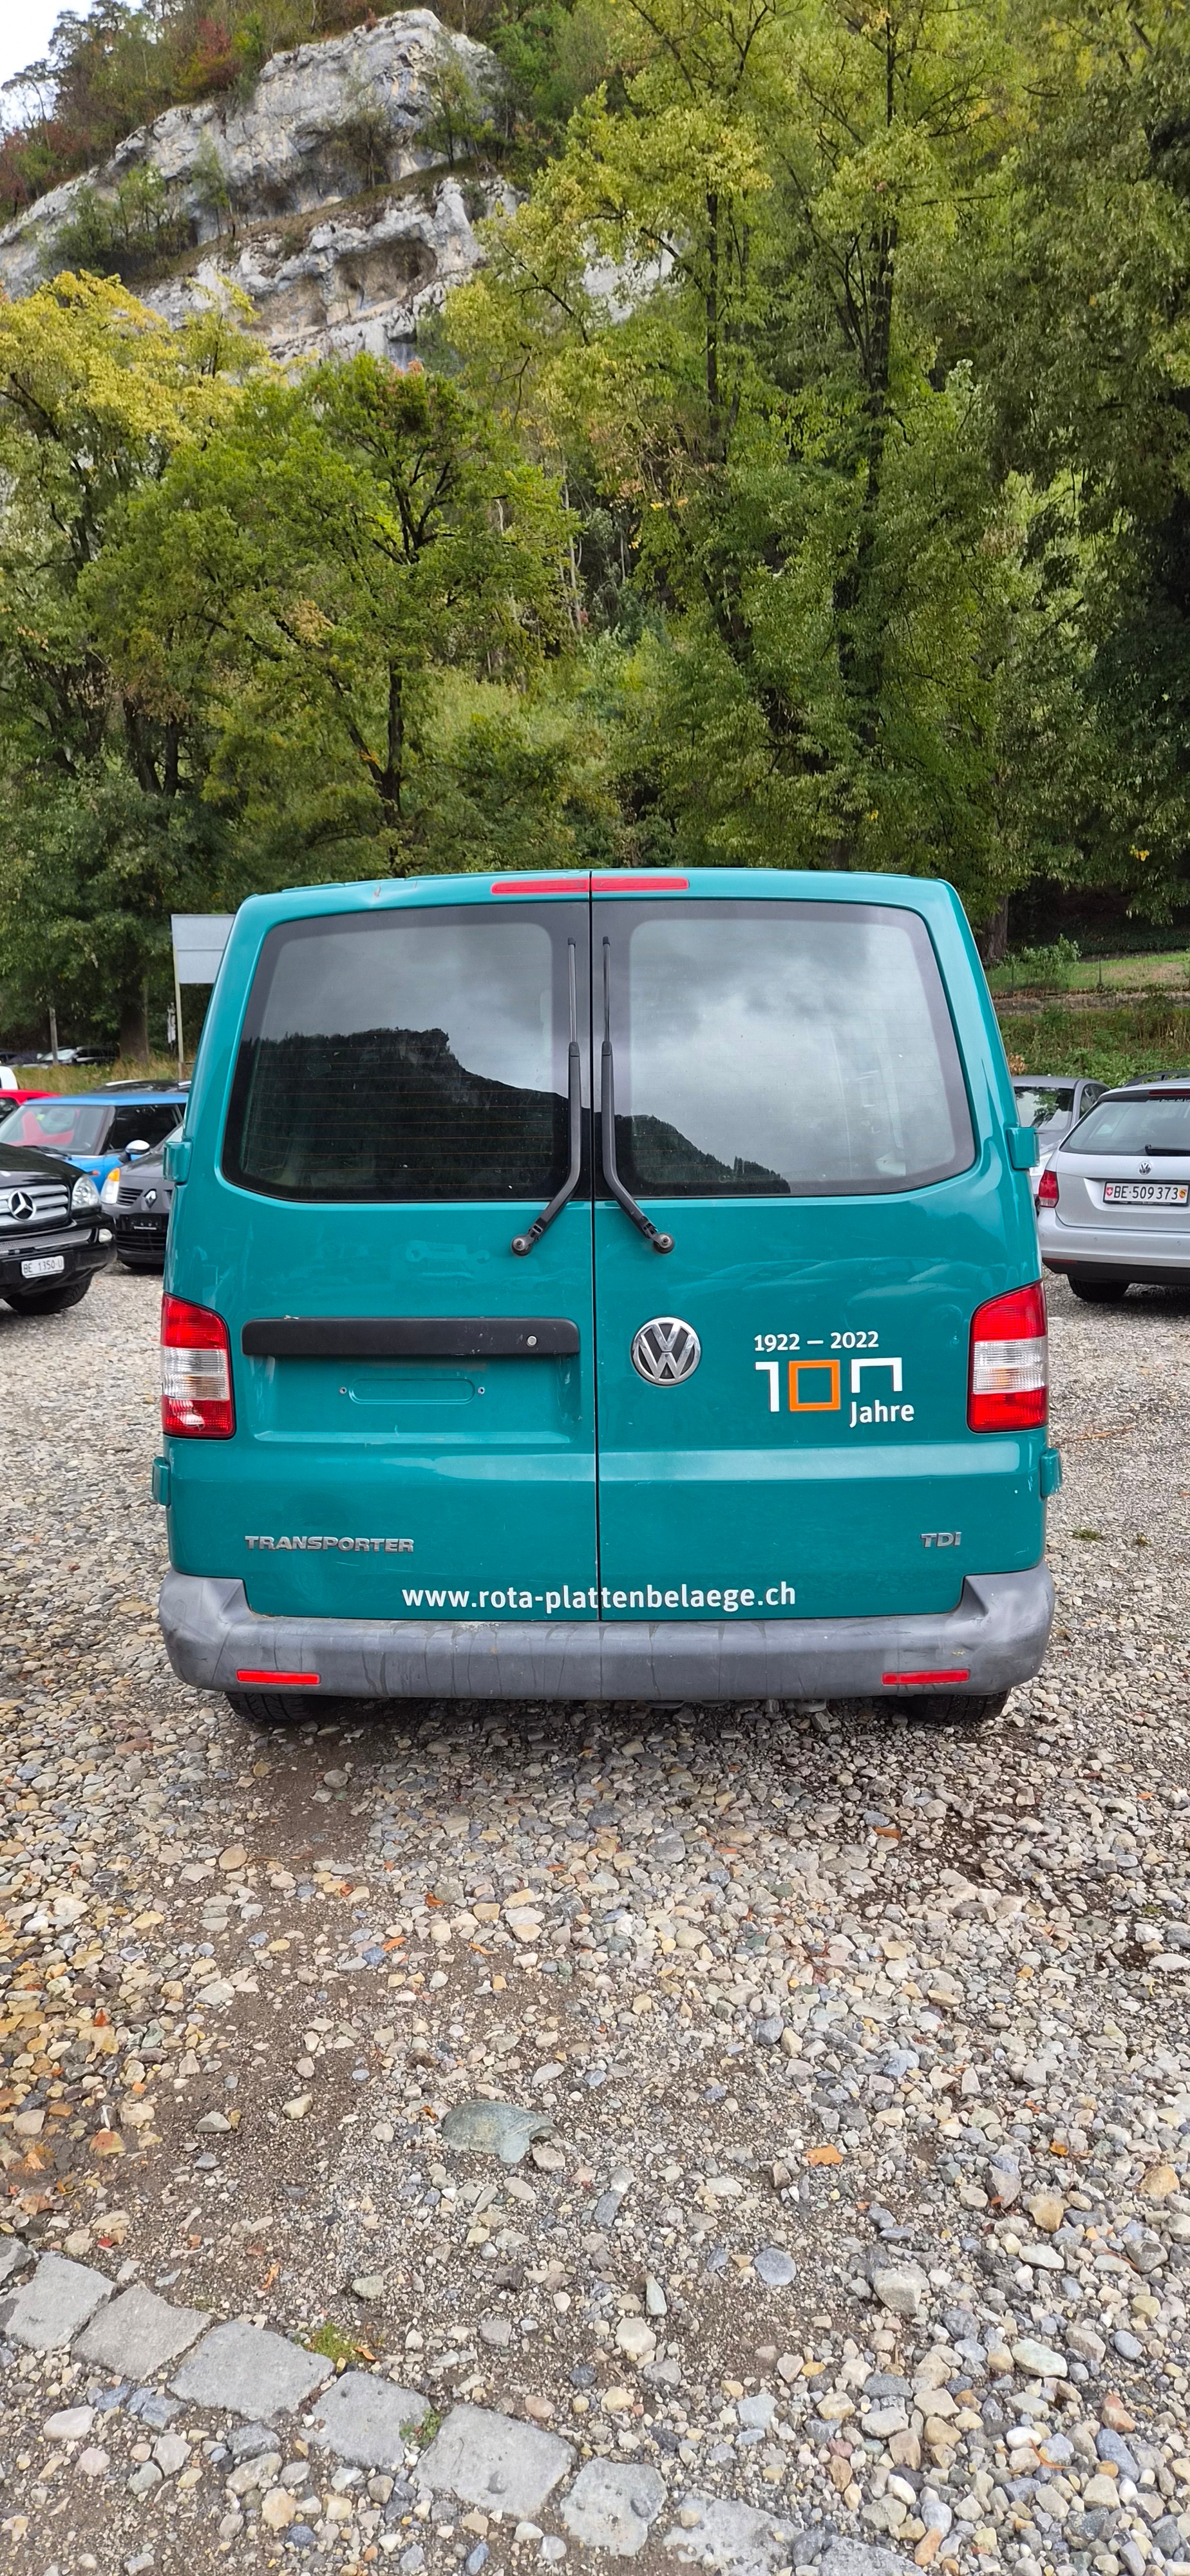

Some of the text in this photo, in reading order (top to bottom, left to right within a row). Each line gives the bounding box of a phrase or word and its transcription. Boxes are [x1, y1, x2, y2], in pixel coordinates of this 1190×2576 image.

[754, 1334, 800, 1352] 1922
[830, 1331, 879, 1349] 2022
[849, 1399, 914, 1428] Jahre
[245, 1536, 414, 1553] TRANSPORTER
[921, 1532, 962, 1548] TDI
[402, 1582, 795, 1613] www.rota-plattenbelaege.ch
